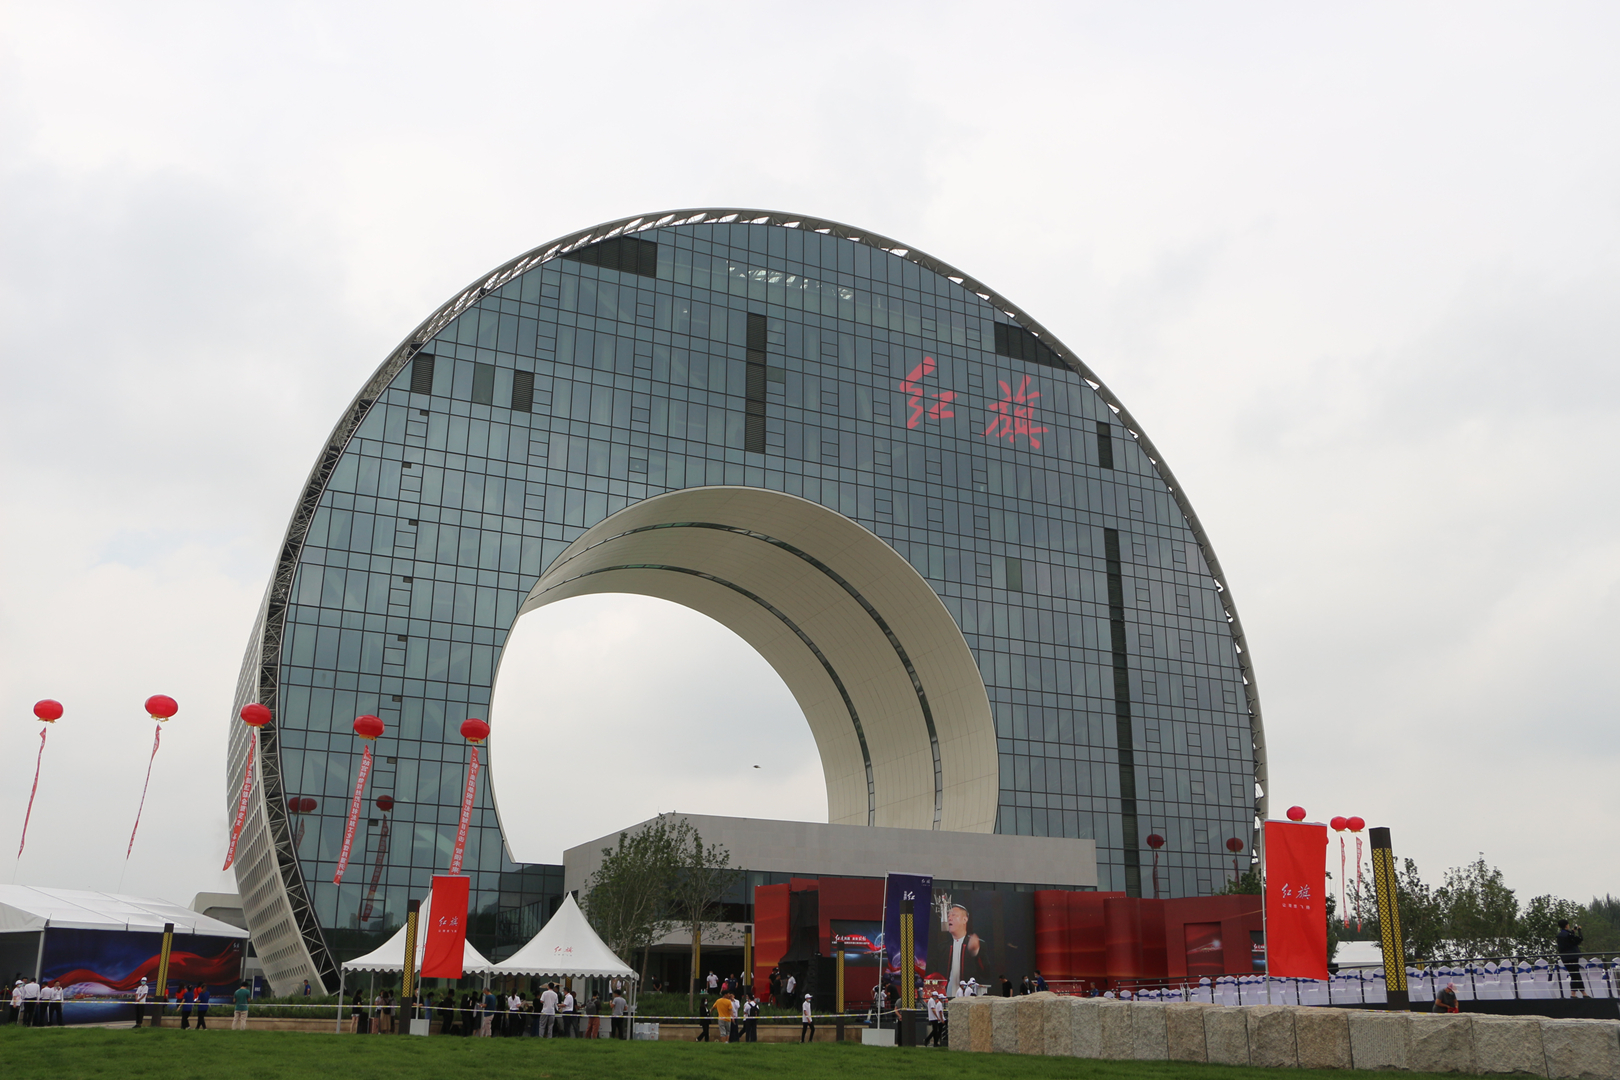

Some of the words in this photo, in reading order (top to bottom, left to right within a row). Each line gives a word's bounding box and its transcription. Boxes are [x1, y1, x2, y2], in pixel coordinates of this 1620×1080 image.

[900, 356, 1049, 450] 红旗
[1281, 883, 1311, 900] 红旗
[438, 916, 459, 927] 红旗
